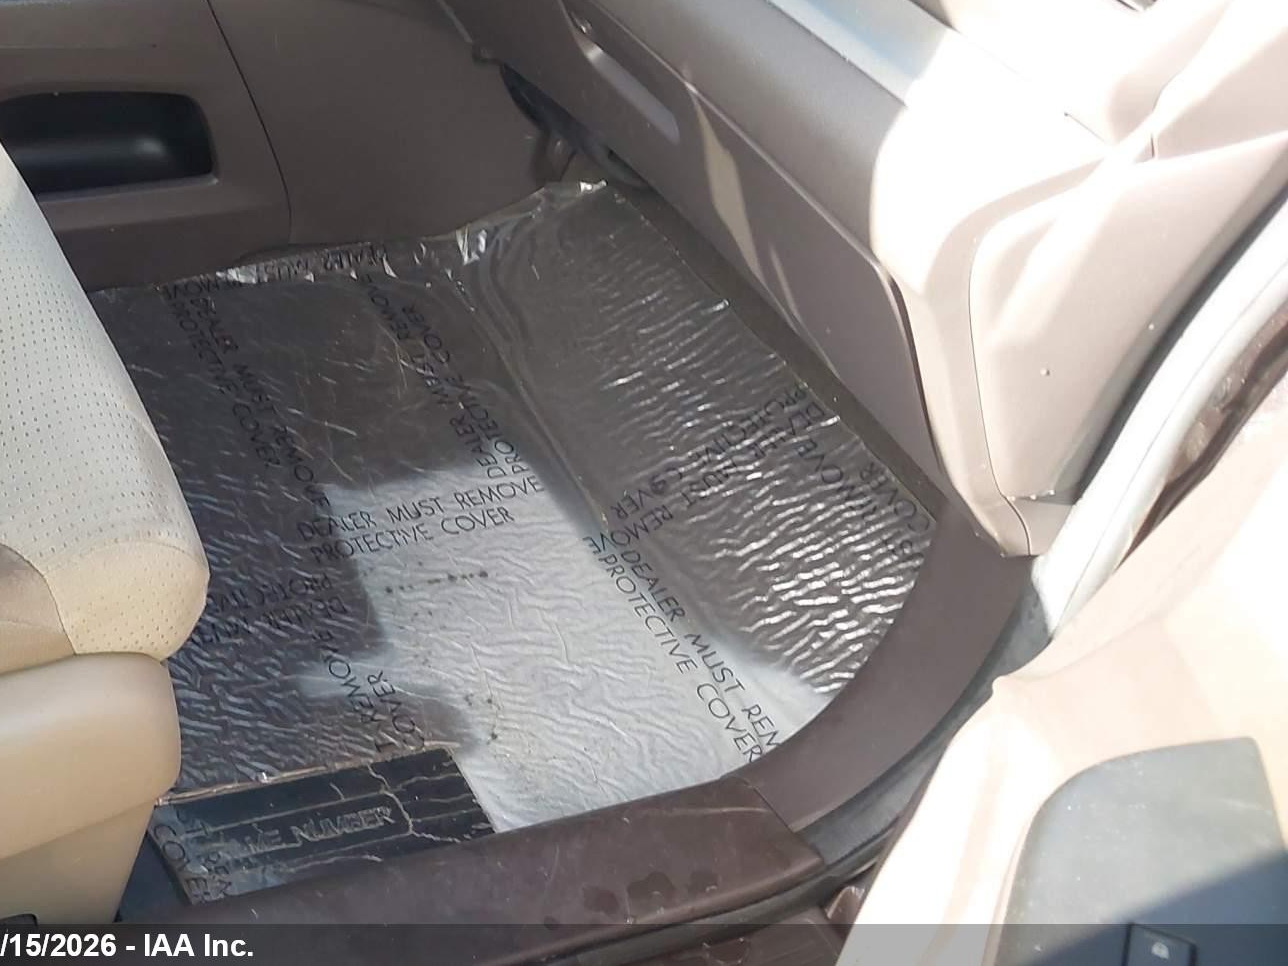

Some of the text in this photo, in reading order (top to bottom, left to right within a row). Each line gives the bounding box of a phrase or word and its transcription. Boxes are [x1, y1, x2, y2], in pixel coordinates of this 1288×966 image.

[450, 415, 508, 480] DEALER
[296, 474, 545, 541] DEALER MUST REMOVE
[310, 505, 515, 564] PROTECTIVE COVER
[582, 504, 674, 555] REMOVE
[598, 553, 763, 763] PROTECTIVE COVER
[620, 549, 686, 622] DEALER
[684, 633, 746, 693] MUST
[312, 631, 377, 723] REMOVE
[367, 669, 426, 751] COVER
